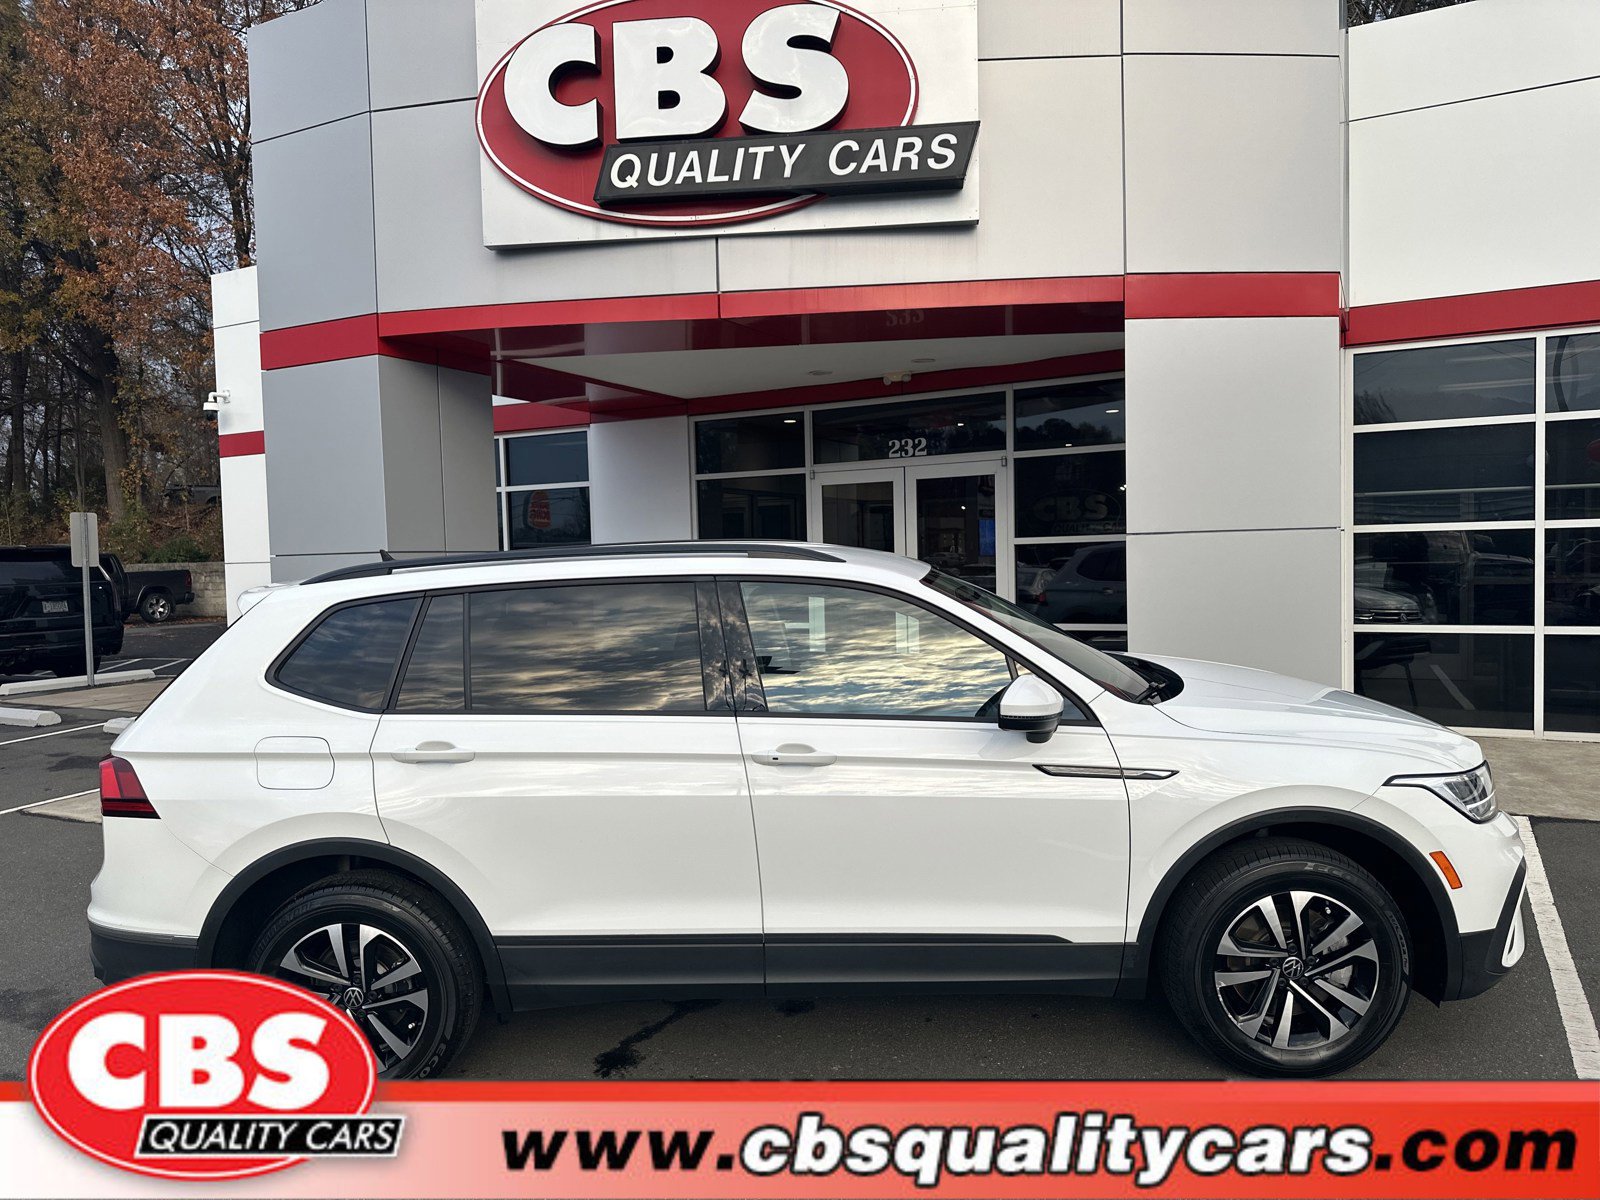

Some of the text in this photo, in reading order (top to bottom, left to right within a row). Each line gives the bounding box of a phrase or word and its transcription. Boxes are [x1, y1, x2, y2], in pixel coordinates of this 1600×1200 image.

[503, 4, 850, 147] CBS
[609, 133, 958, 190] QUALITY CARS
[888, 437, 928, 458] 232
[1033, 494, 1109, 522] CBS
[412, 1042, 447, 1080] ECO
